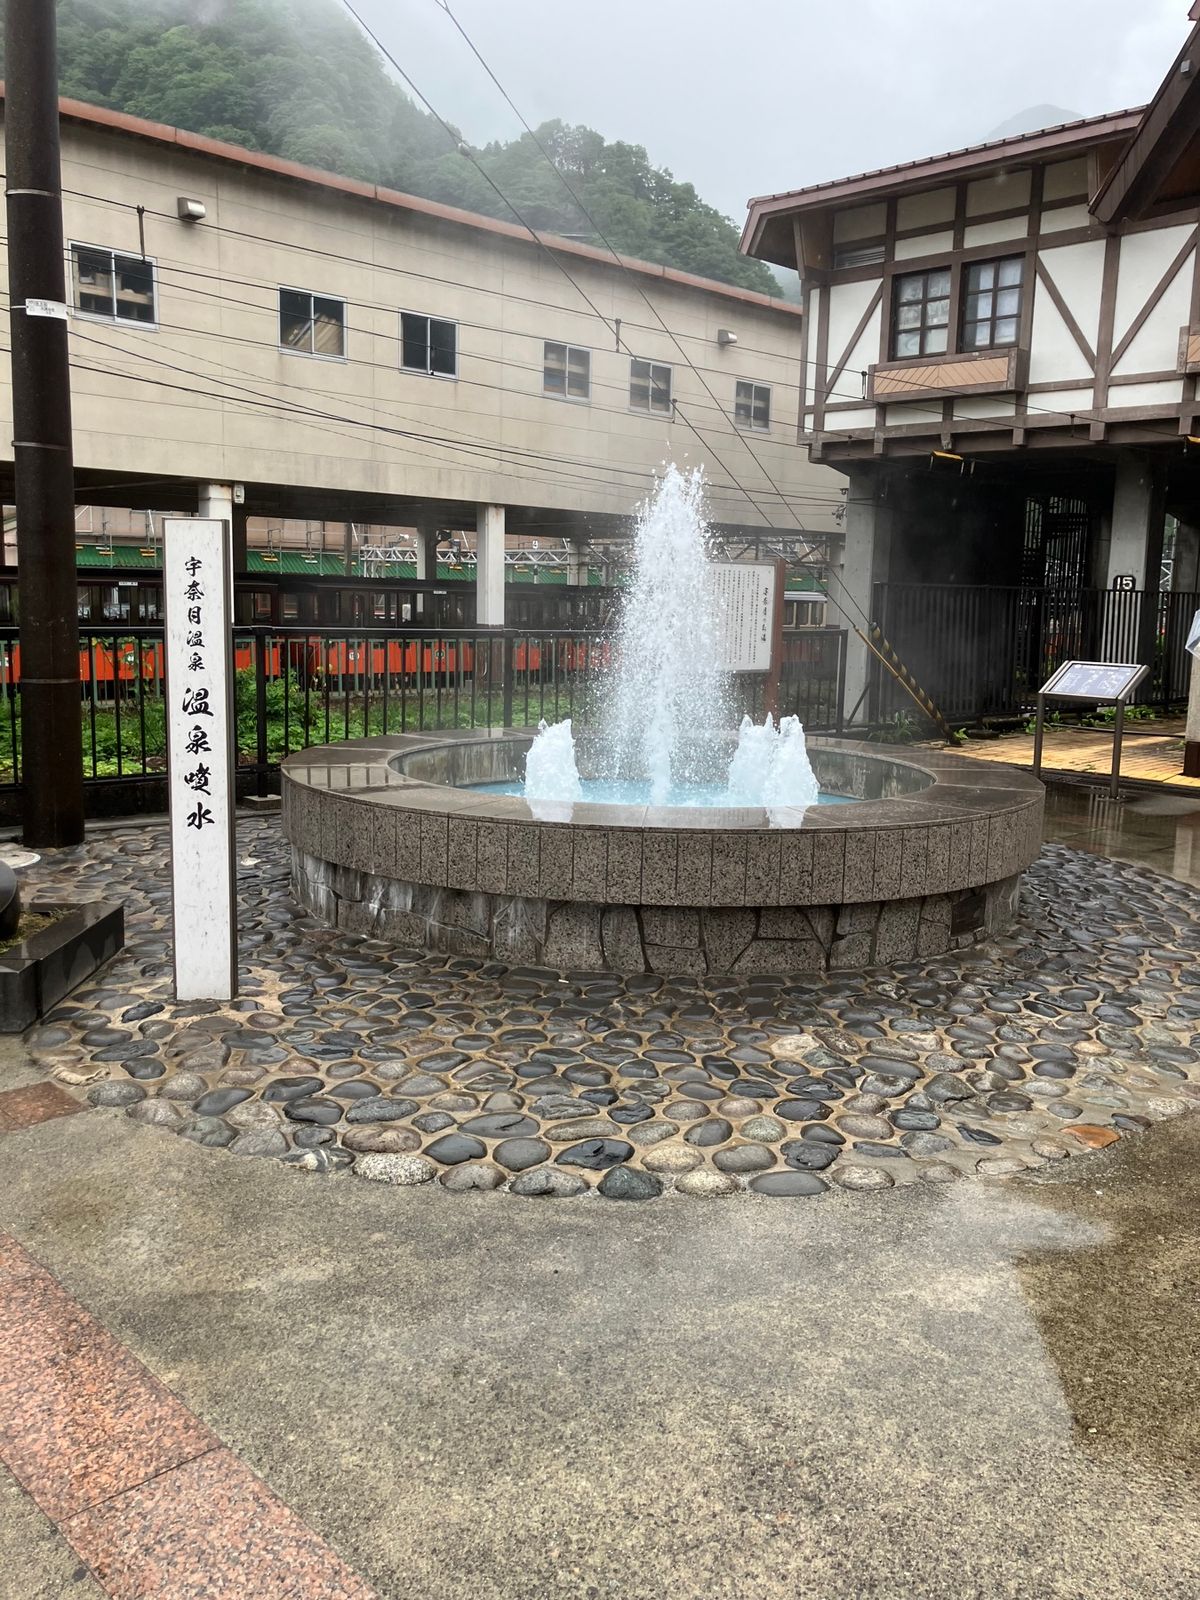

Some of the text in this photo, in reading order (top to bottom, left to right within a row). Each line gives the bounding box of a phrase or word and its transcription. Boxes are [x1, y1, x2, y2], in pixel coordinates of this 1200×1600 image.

[1116, 576, 1133, 590] 15
[182, 556, 215, 830] 宇奈月温泉 温泉噴水
